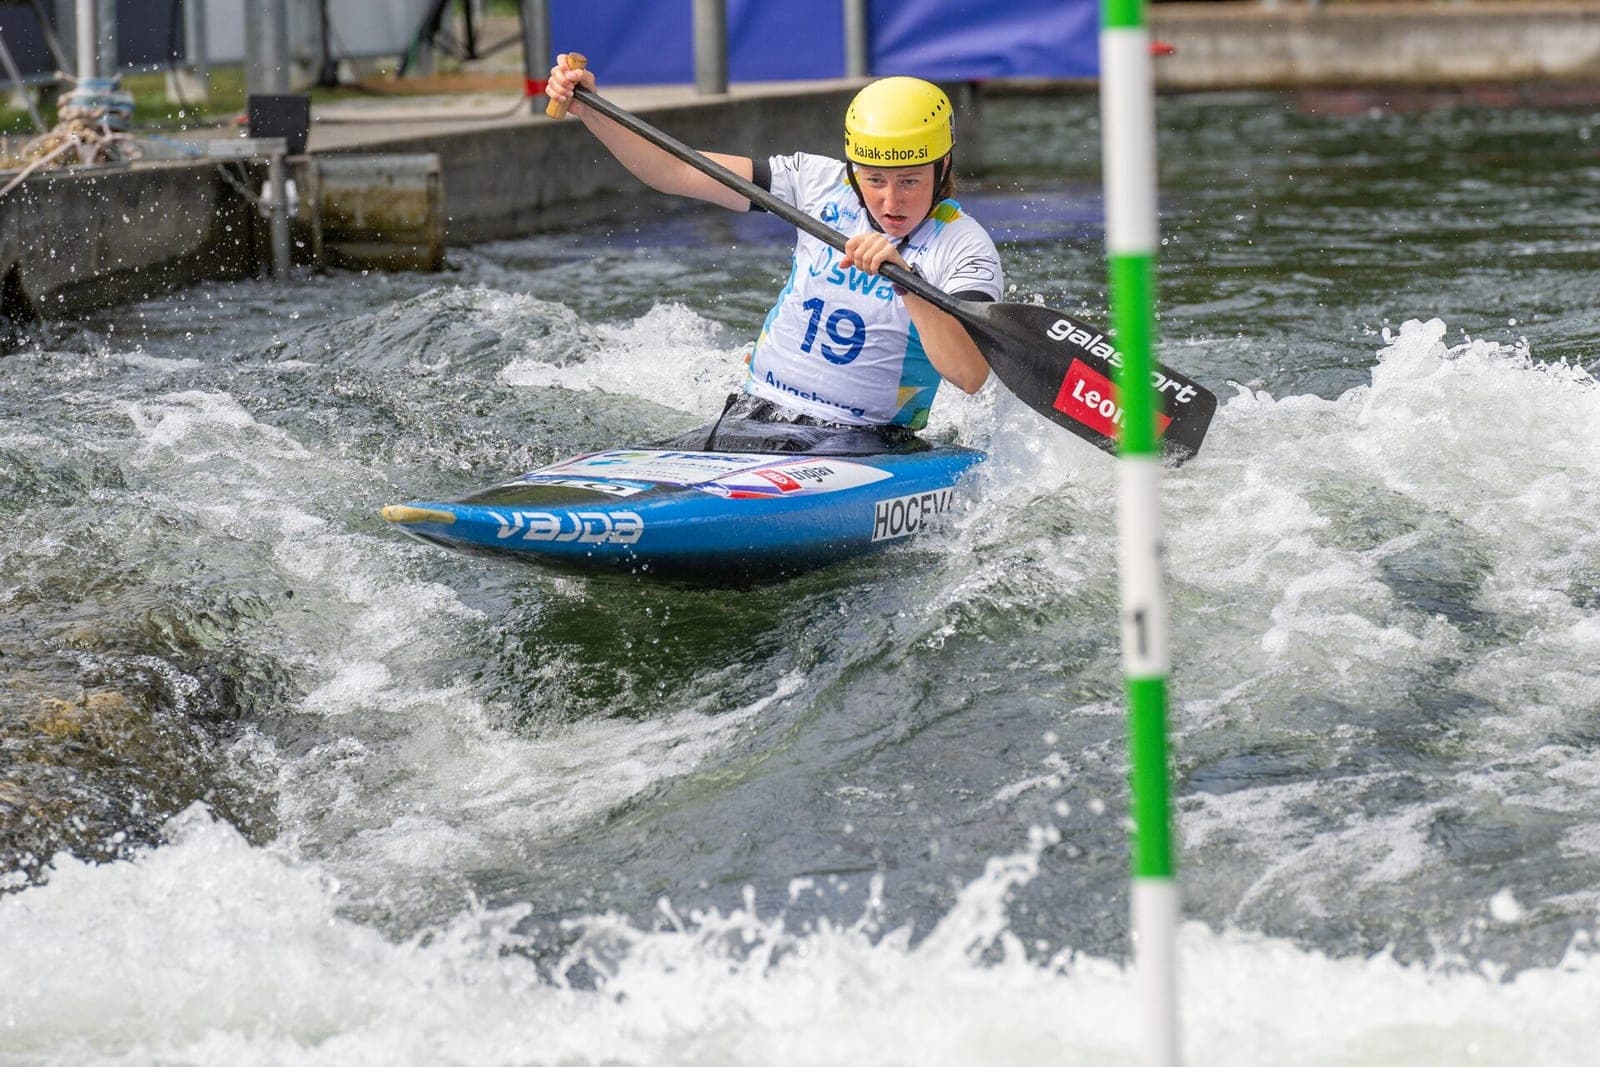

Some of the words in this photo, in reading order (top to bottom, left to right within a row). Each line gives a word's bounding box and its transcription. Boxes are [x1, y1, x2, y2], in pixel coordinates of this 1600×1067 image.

[854, 143, 928, 161] kajak-shop.si
[800, 297, 866, 365] 19
[1046, 319, 1198, 404] galasort
